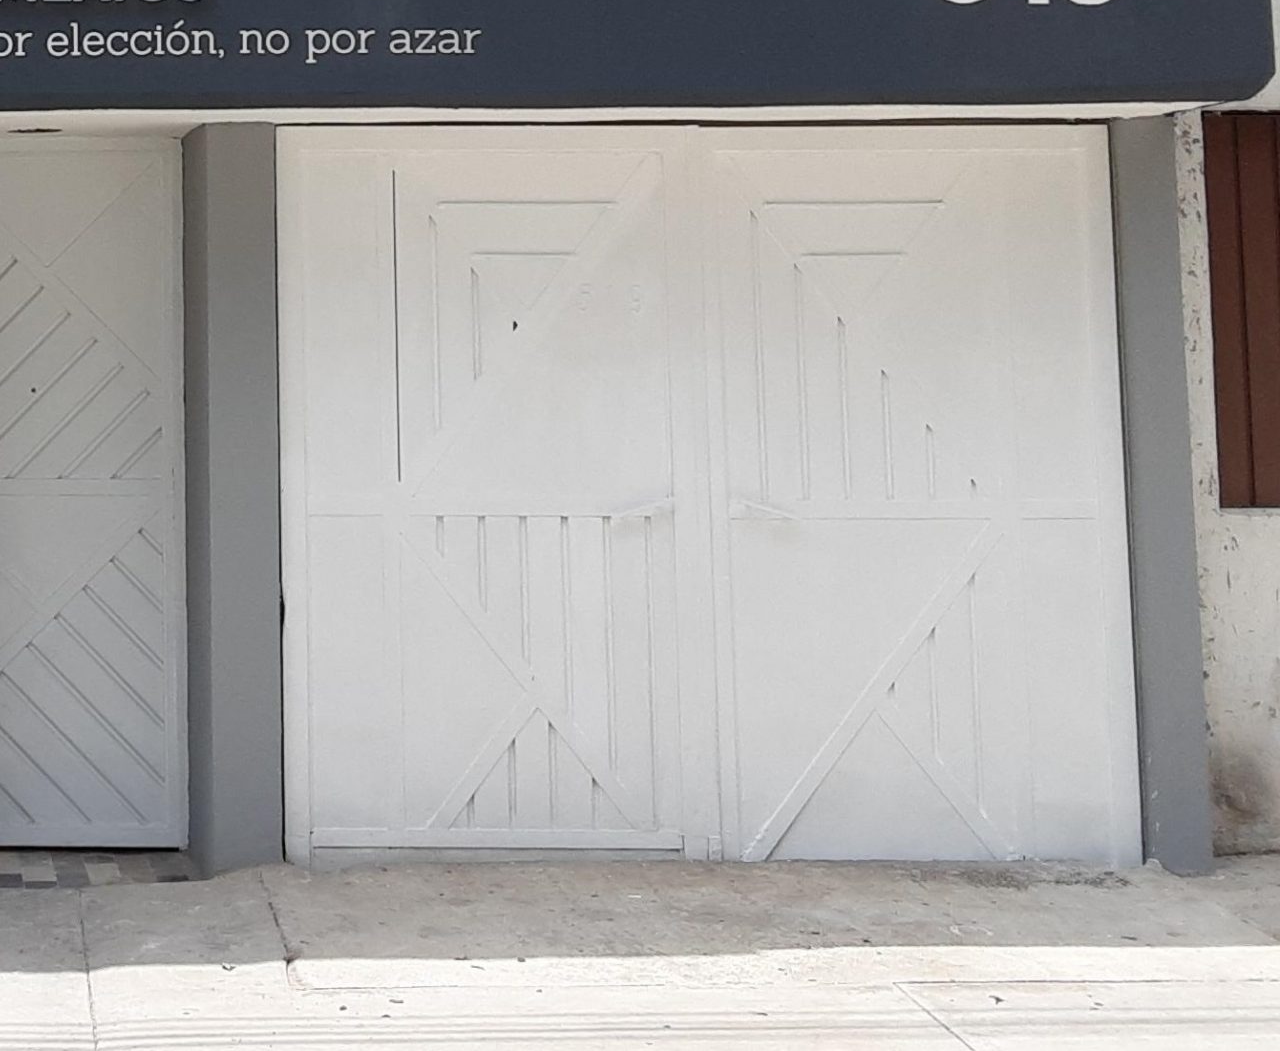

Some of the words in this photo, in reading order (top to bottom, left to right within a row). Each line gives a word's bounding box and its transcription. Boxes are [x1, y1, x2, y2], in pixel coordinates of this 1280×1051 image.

[46, 20, 225, 59] elección,
[239, 29, 290, 55] no
[305, 29, 376, 64] por
[389, 29, 482, 55] azar
